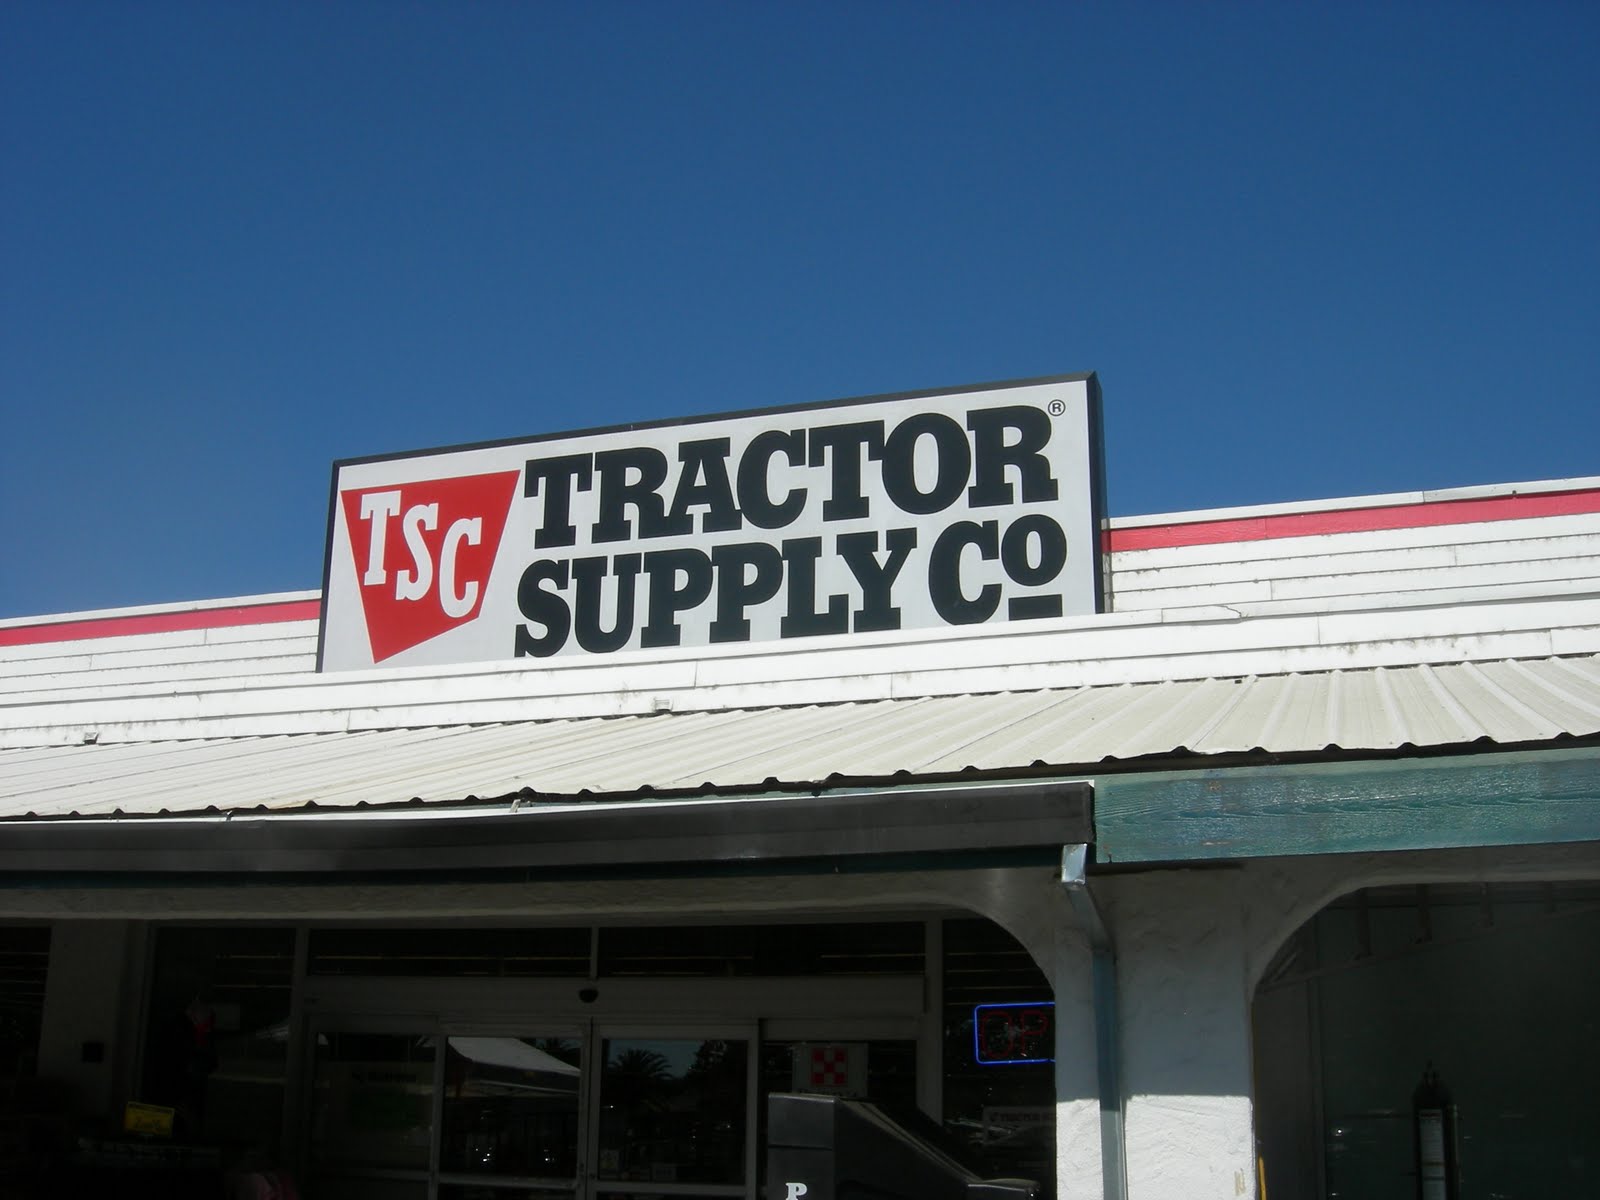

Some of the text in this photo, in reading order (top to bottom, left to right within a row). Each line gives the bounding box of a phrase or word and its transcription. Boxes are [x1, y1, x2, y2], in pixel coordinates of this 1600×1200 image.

[524, 405, 1059, 549] TRACTOR
[360, 489, 482, 618] TSC
[514, 527, 918, 658] SUPPLY
